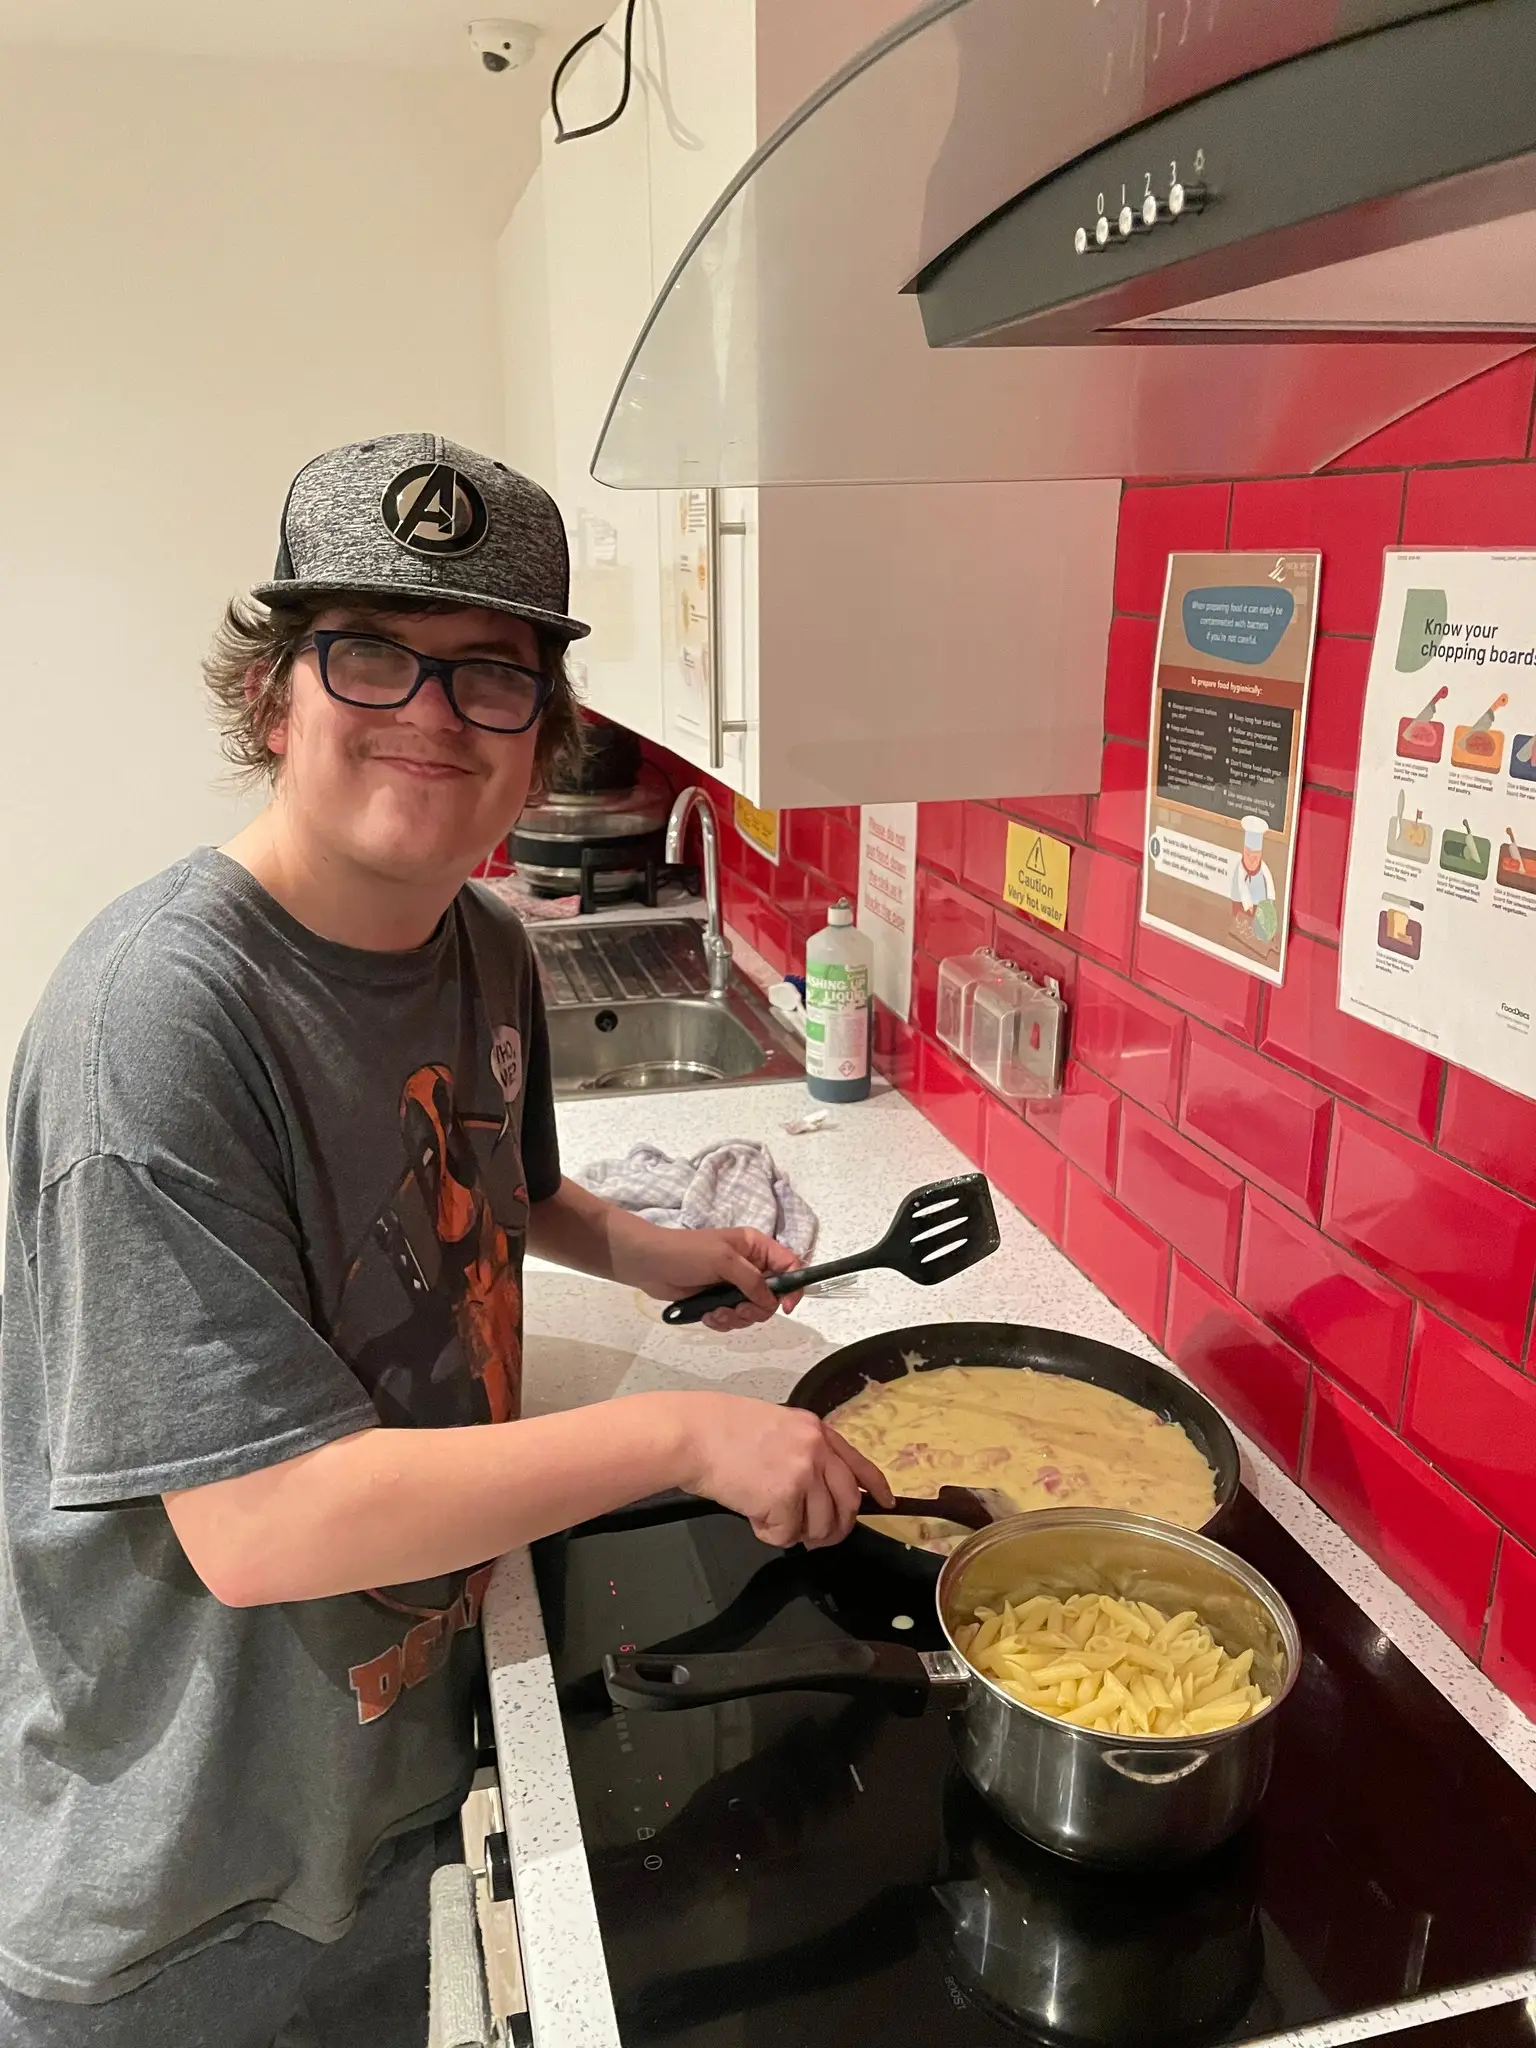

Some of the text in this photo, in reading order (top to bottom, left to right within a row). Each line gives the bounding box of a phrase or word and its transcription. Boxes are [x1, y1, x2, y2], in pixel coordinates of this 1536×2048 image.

[1144, 172, 1152, 197] 2
[1170, 160, 1177, 186] 3
[1424, 618, 1498, 641] Know your
[1421, 640, 1485, 666] chopping
[1192, 676, 1262, 696] To prepare food hygienically:
[1018, 869, 1054, 900] Caution
[1008, 884, 1062, 922] Very hot water
[1501, 1002, 1530, 1021] FoodDocs
